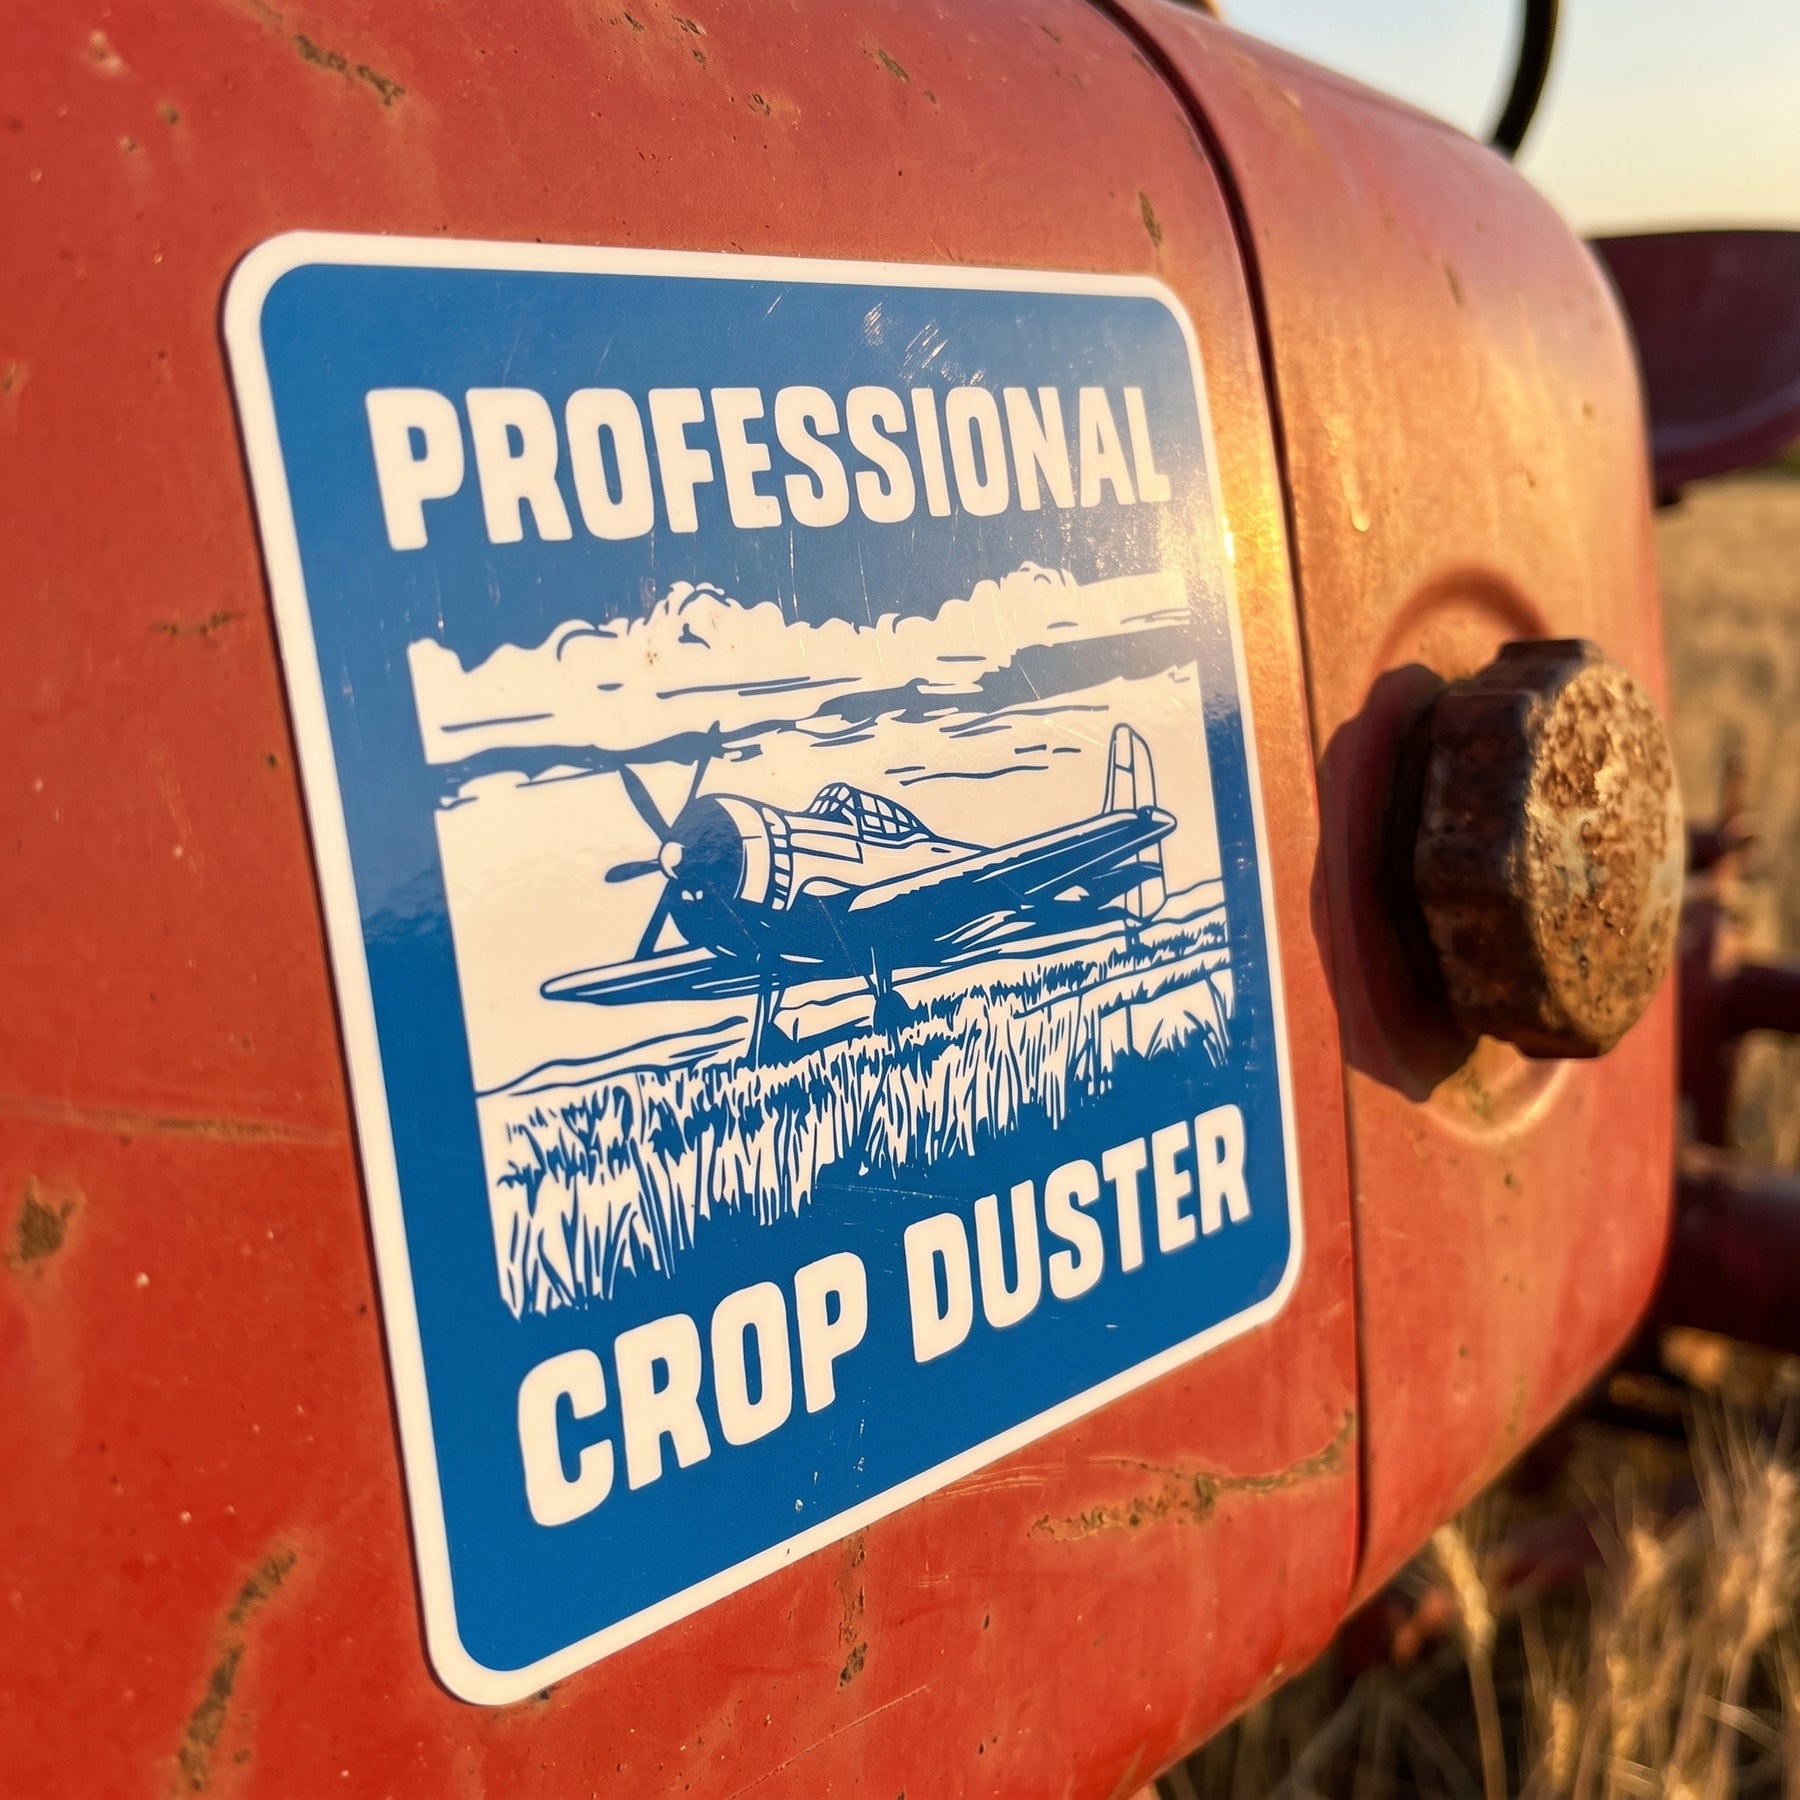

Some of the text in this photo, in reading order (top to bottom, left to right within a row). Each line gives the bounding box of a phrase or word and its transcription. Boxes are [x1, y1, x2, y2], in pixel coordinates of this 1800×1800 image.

[365, 385, 1170, 551] PROFESSIONAL
[518, 1104, 1250, 1527] CROP DUSTER
